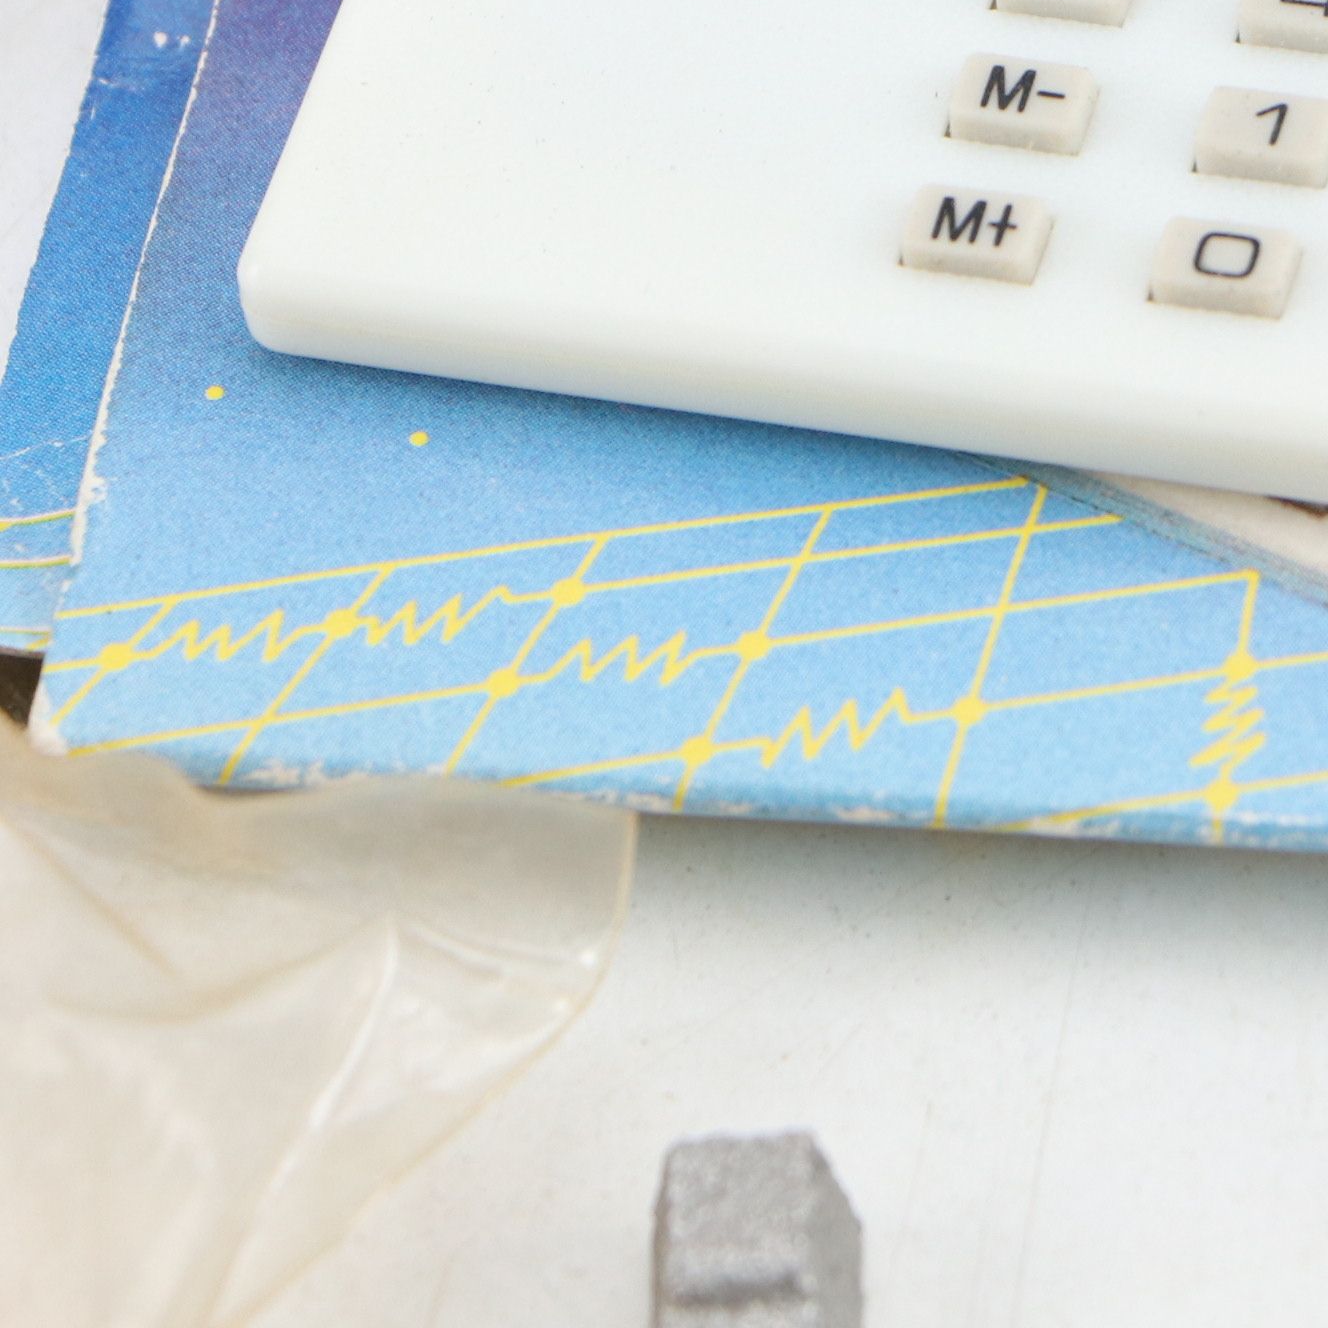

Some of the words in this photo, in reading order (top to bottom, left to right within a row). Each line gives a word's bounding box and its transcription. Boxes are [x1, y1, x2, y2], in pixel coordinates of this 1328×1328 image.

[980, 65, 1066, 112] M-
[1254, 103, 1290, 147] 1
[930, 197, 1019, 249] M+
[1192, 232, 1261, 280] 0
